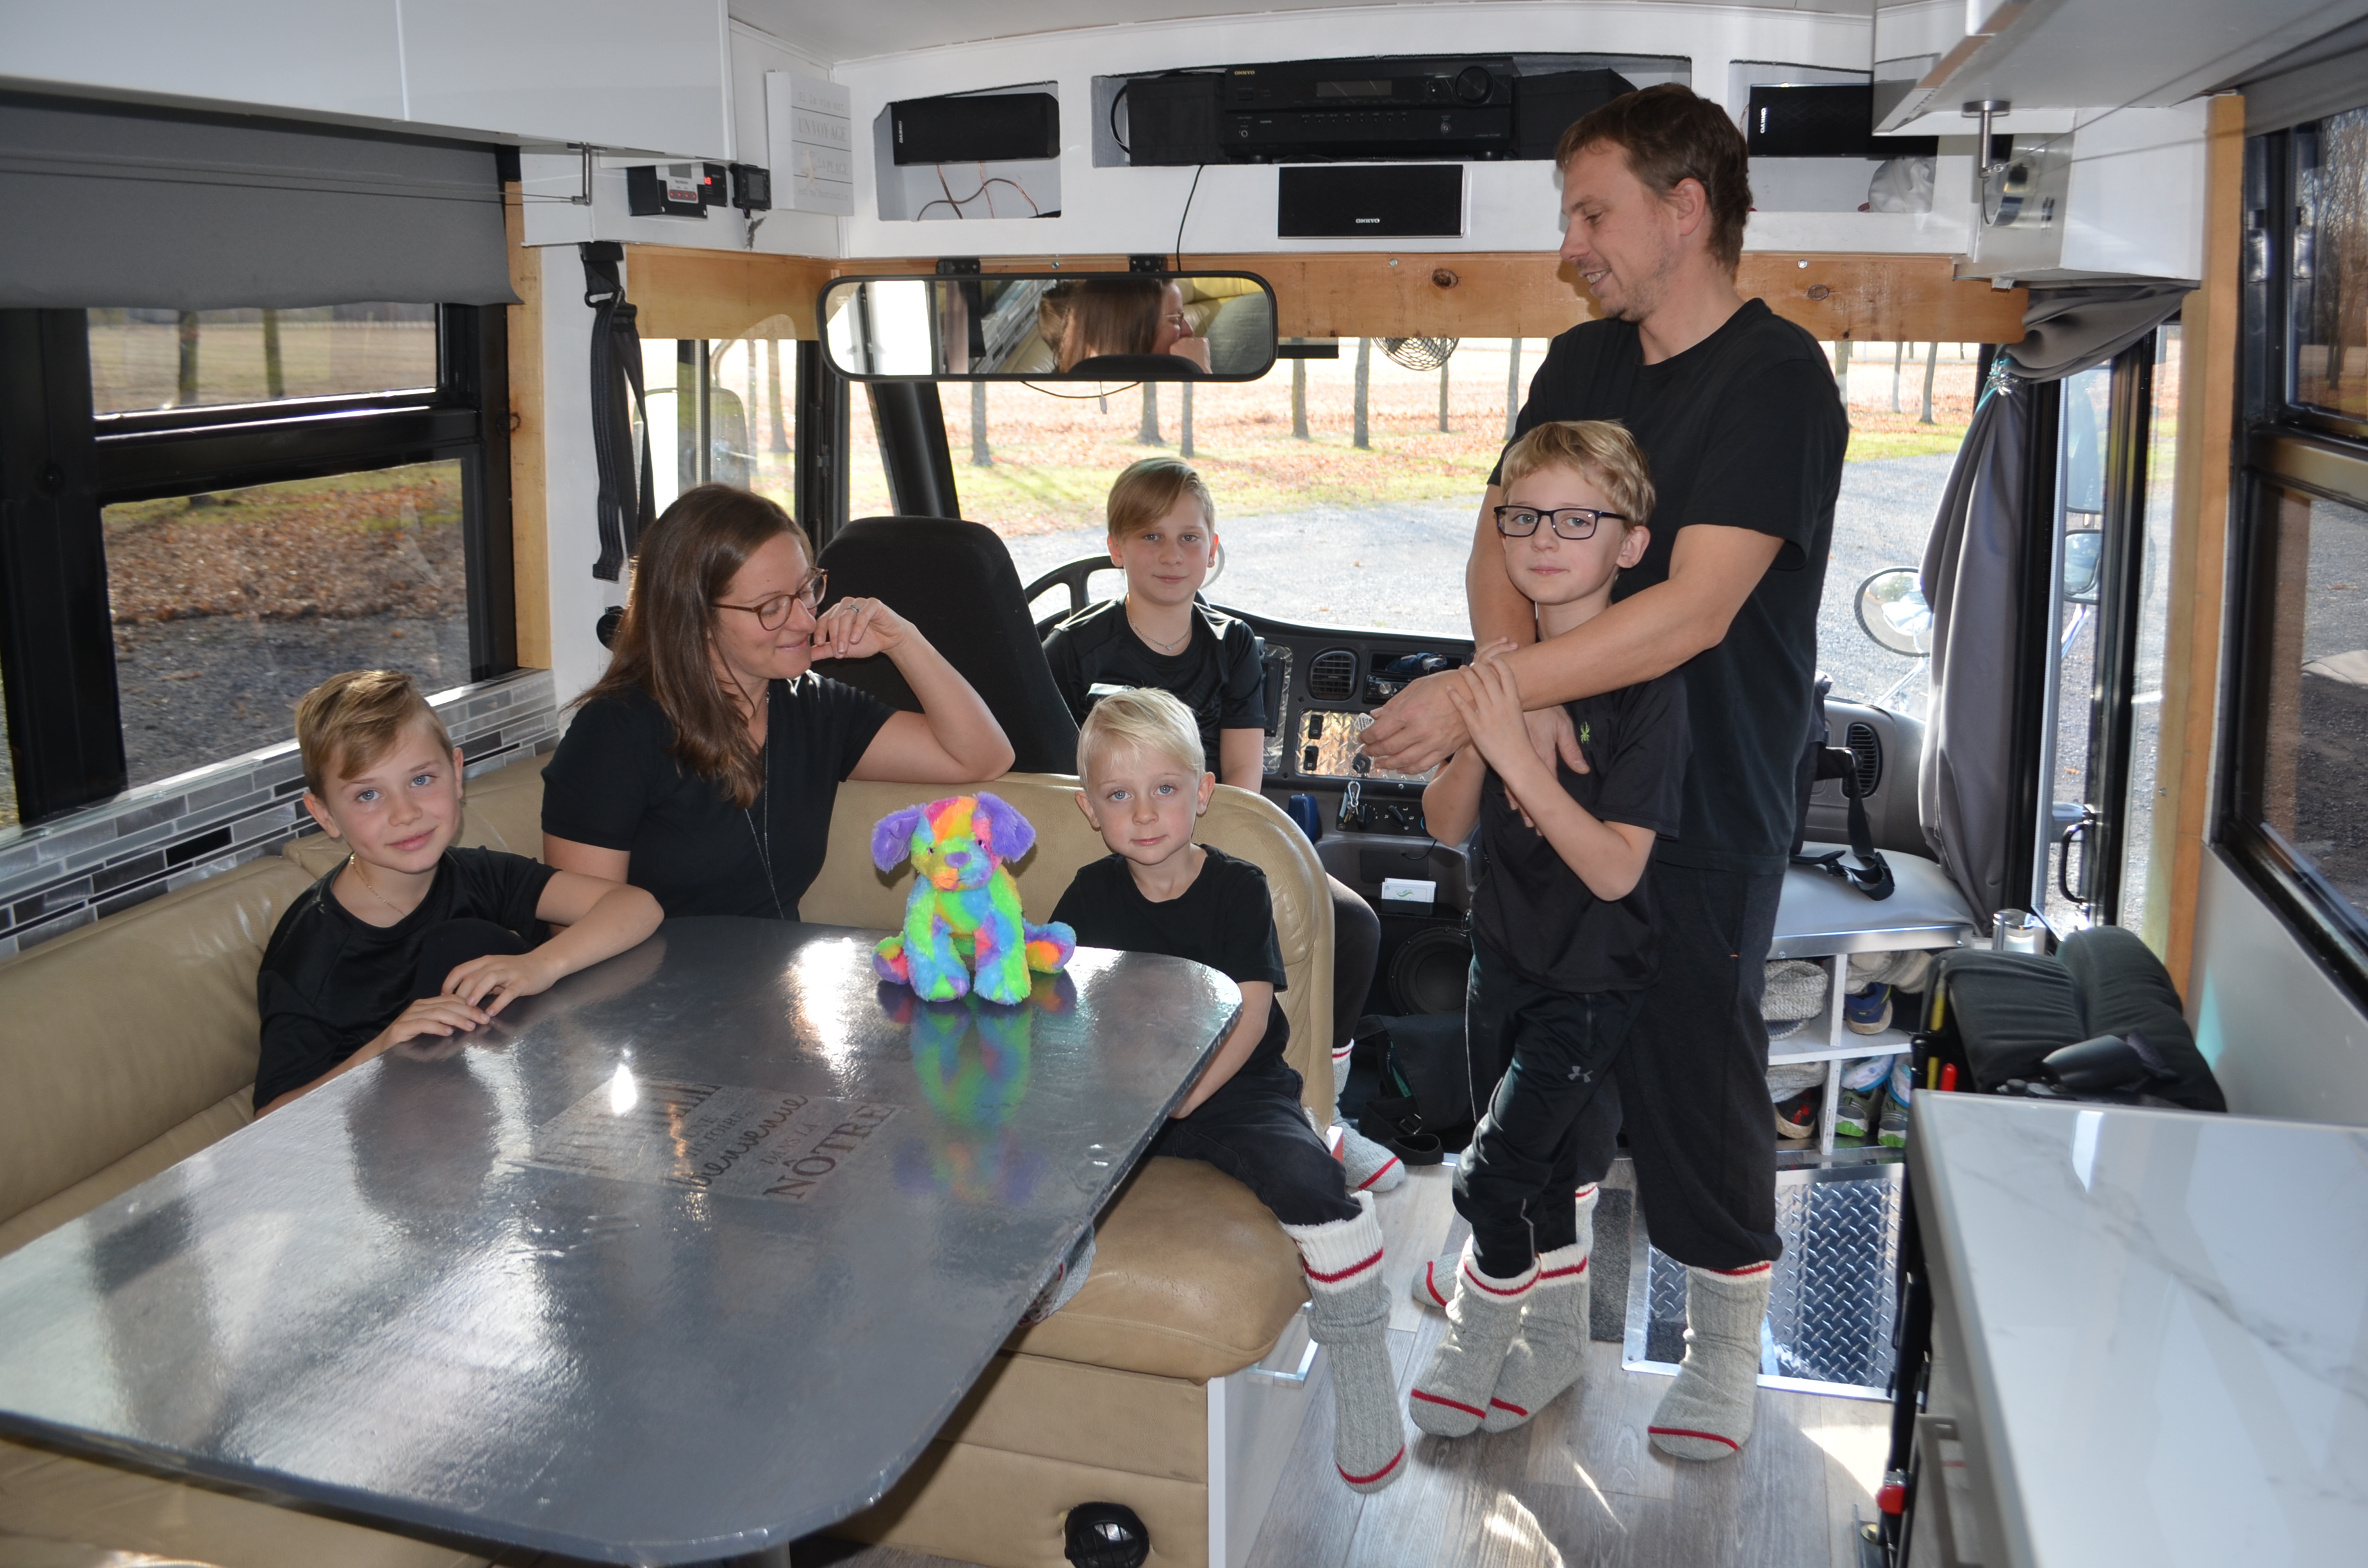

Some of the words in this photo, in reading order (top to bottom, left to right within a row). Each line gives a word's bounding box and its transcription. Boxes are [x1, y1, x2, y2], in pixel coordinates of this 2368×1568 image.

[798, 117, 810, 134] UN
[811, 120, 847, 142] VOYAGE
[826, 160, 849, 176] PLAGE
[759, 1137, 801, 1166] DANS
[762, 1105, 896, 1200] NÔTRE
